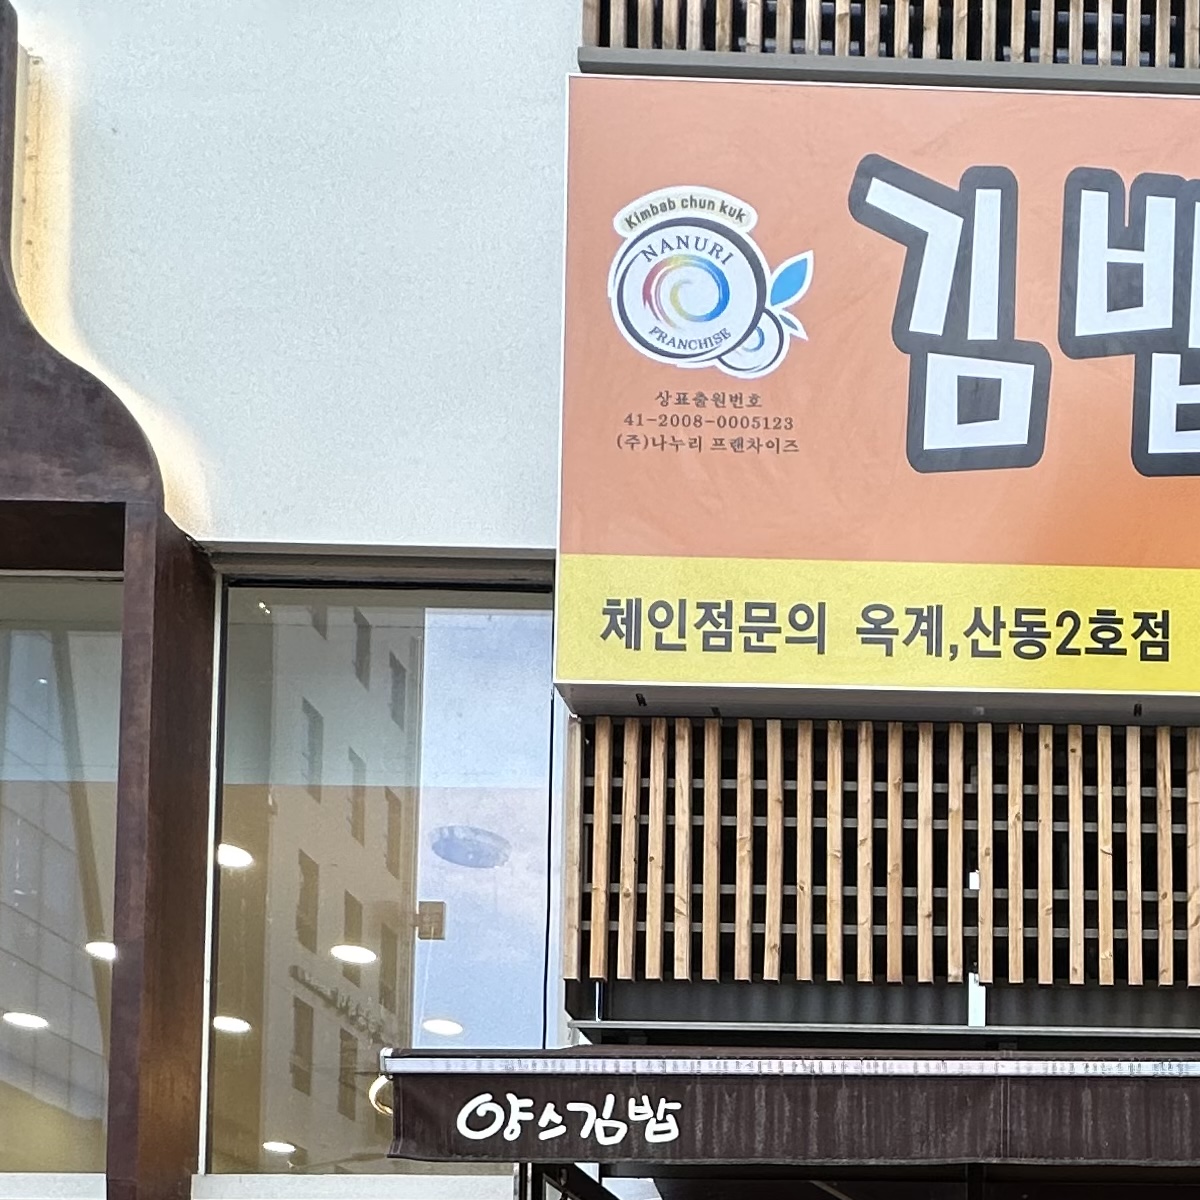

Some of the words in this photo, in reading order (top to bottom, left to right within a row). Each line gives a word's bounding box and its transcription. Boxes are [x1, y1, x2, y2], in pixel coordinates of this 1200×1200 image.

[624, 197, 677, 229] Kimbab
[681, 195, 715, 211] chun
[719, 203, 747, 223] kuk
[641, 235, 734, 265] NANURI
[649, 326, 731, 350] FRANCHISE
[655, 390, 762, 408] 상표출원번호
[624, 412, 794, 431] 41-2008-0005123
[616, 434, 702, 453] (주)나누리
[600, 597, 827, 656] 체인점문의
[855, 602, 1171, 663] 옥계,산동2호점
[456, 1092, 682, 1146] 양스김밥
